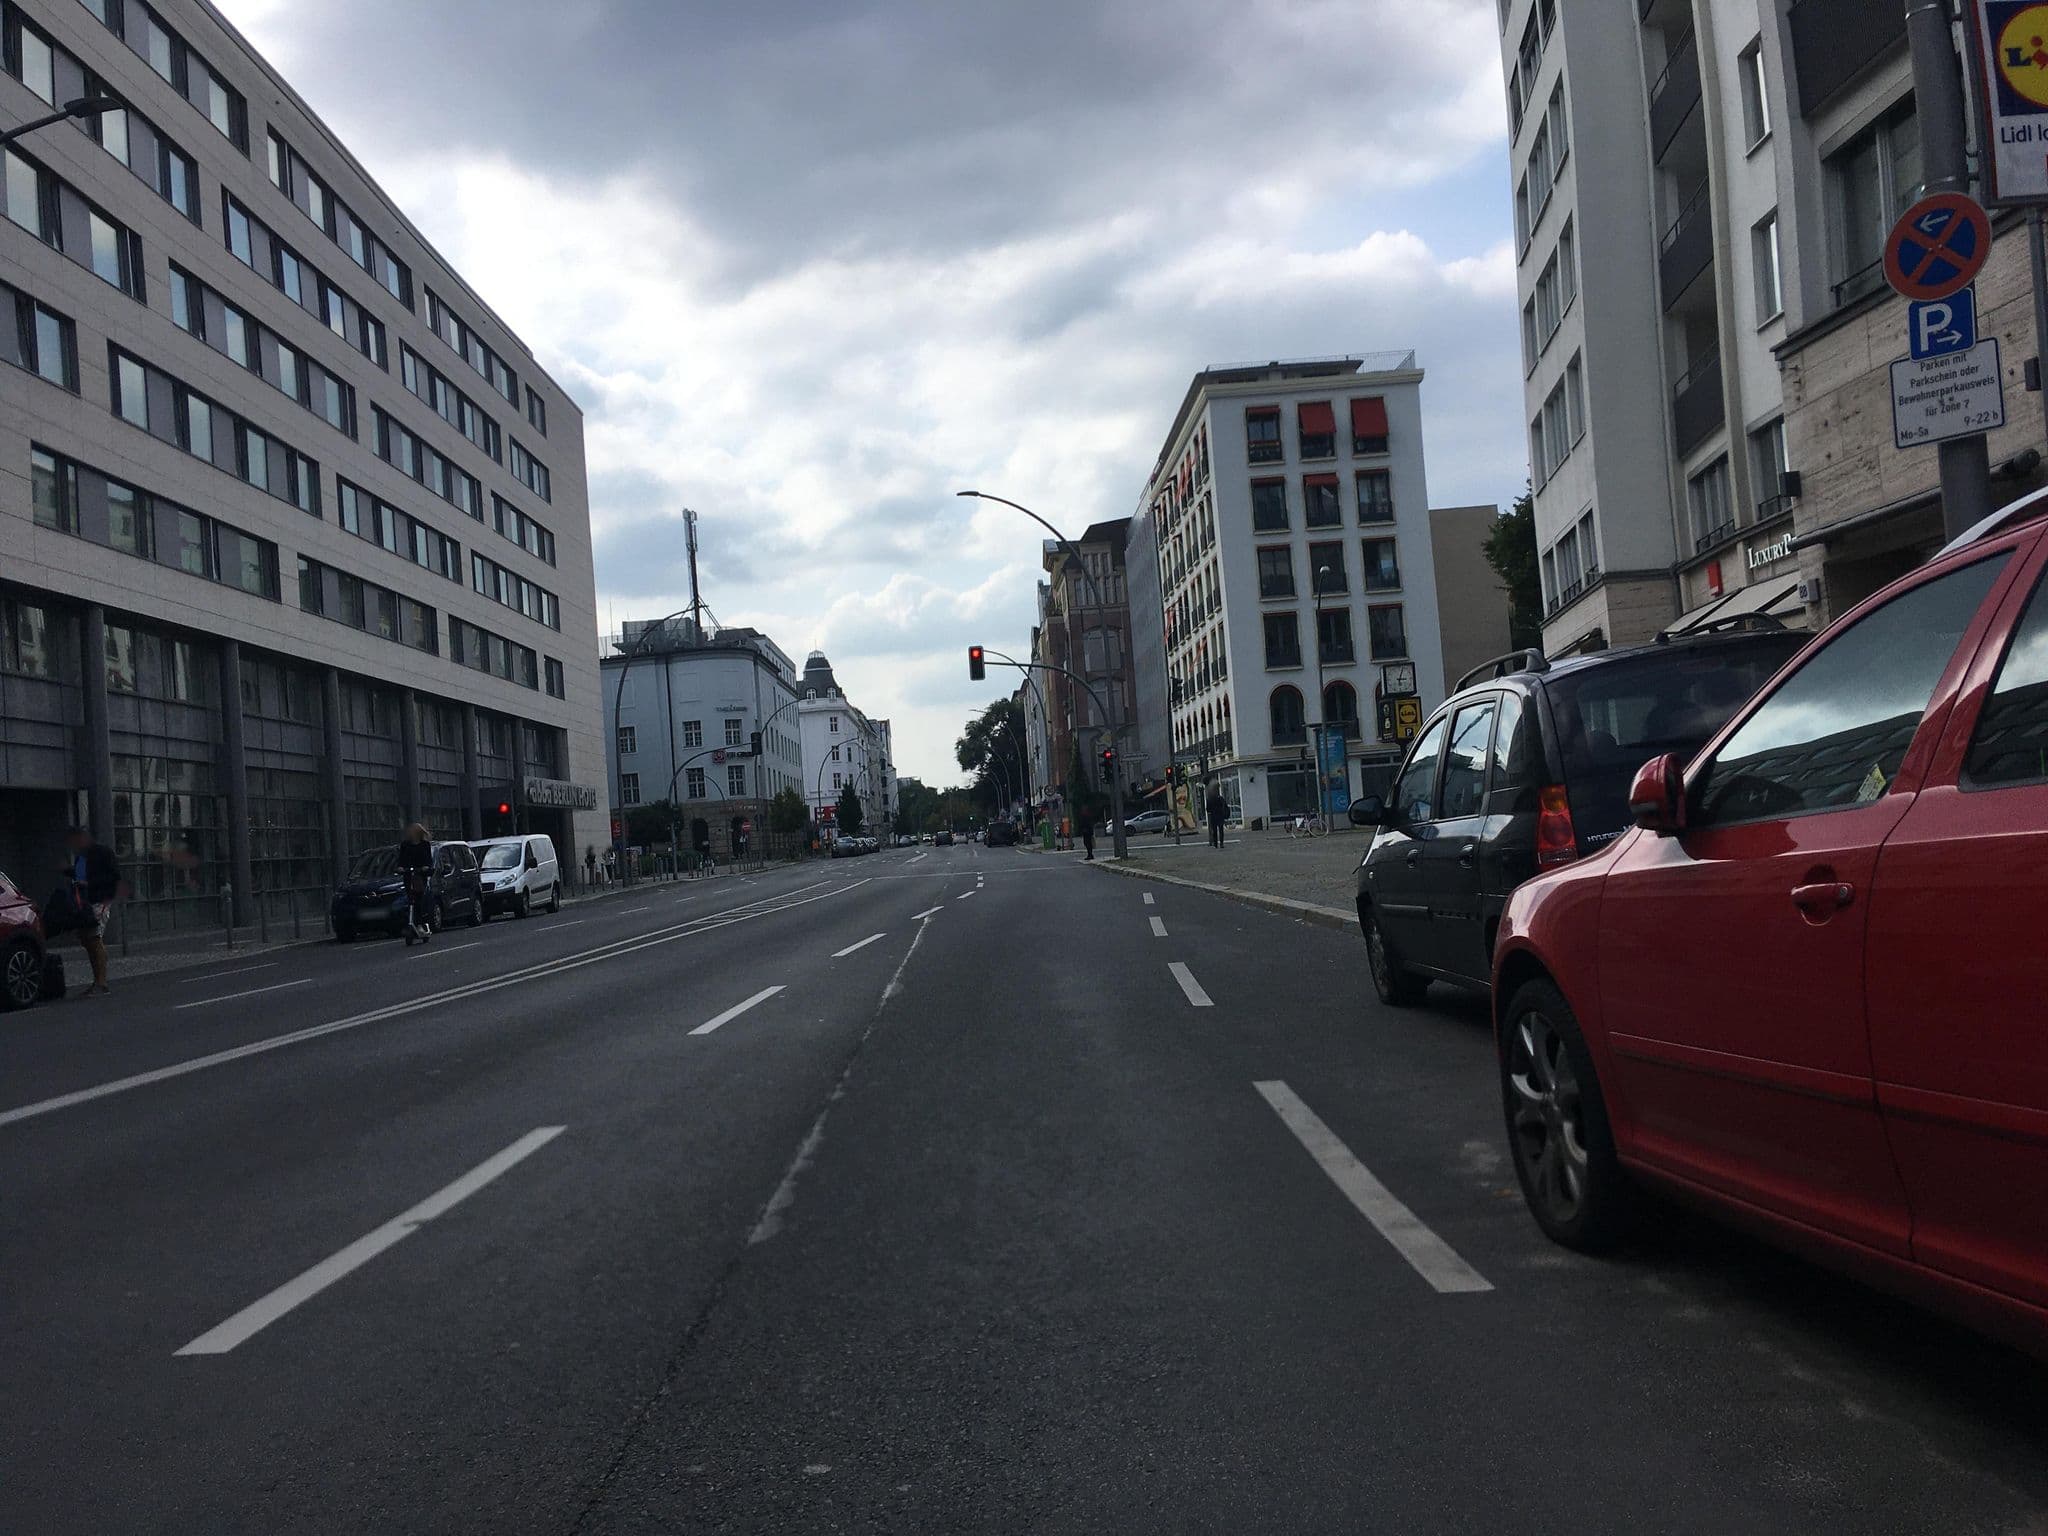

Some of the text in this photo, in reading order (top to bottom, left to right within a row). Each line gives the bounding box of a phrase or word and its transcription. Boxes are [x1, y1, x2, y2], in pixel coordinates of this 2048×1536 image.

[2001, 124, 2032, 143] Lidl
[1919, 303, 1952, 352] P
[1920, 353, 1967, 372] Parken mit
[1910, 365, 1979, 388] Parkschein oder
[1899, 376, 1995, 406] Bewohnerparkausweis
[1940, 401, 1961, 414] Zone
[1964, 411, 1990, 427] 9-22
[1900, 426, 1929, 440] Mo-Sa
